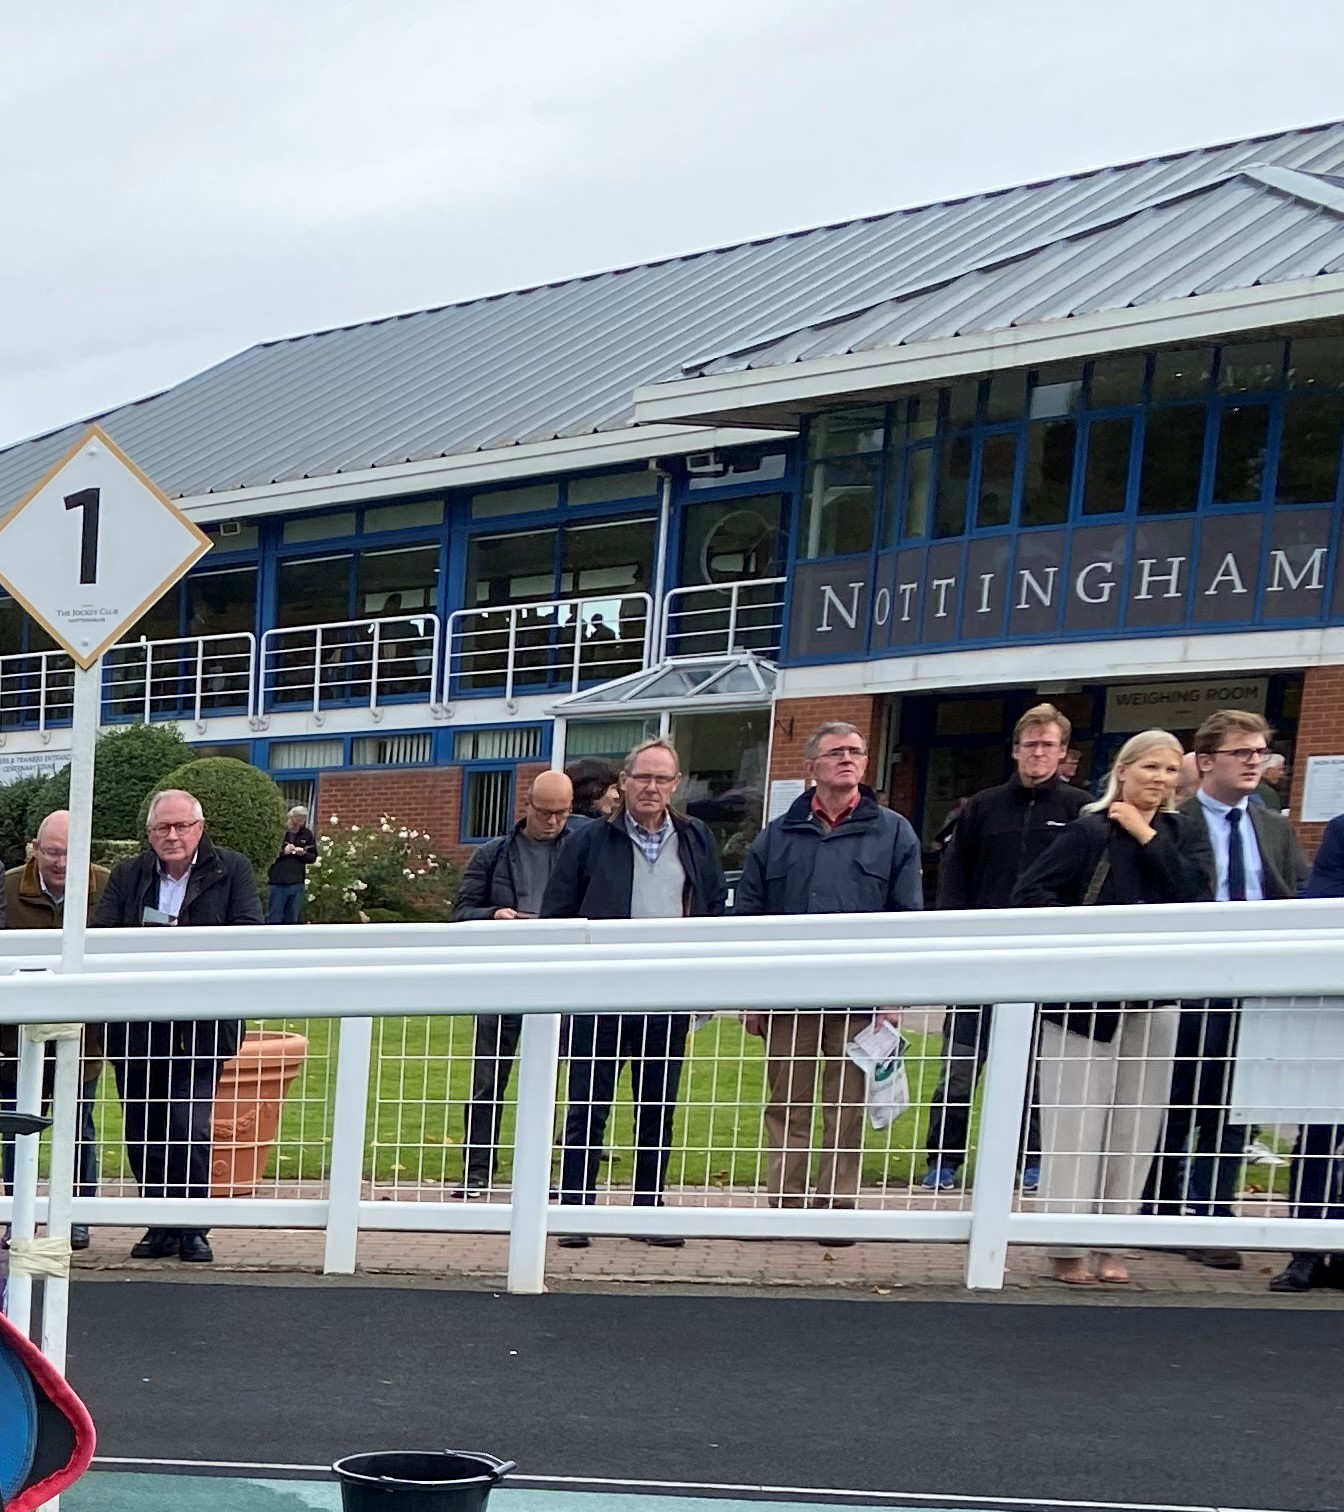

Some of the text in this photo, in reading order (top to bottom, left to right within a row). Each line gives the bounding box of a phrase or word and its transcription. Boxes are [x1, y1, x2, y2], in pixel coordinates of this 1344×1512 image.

[63, 487, 101, 585] 1
[815, 547, 1329, 632] NOTTINGHAM
[1115, 686, 1260, 706] WEIGHING ROOM
[45, 753, 72, 761] ENTRANC
